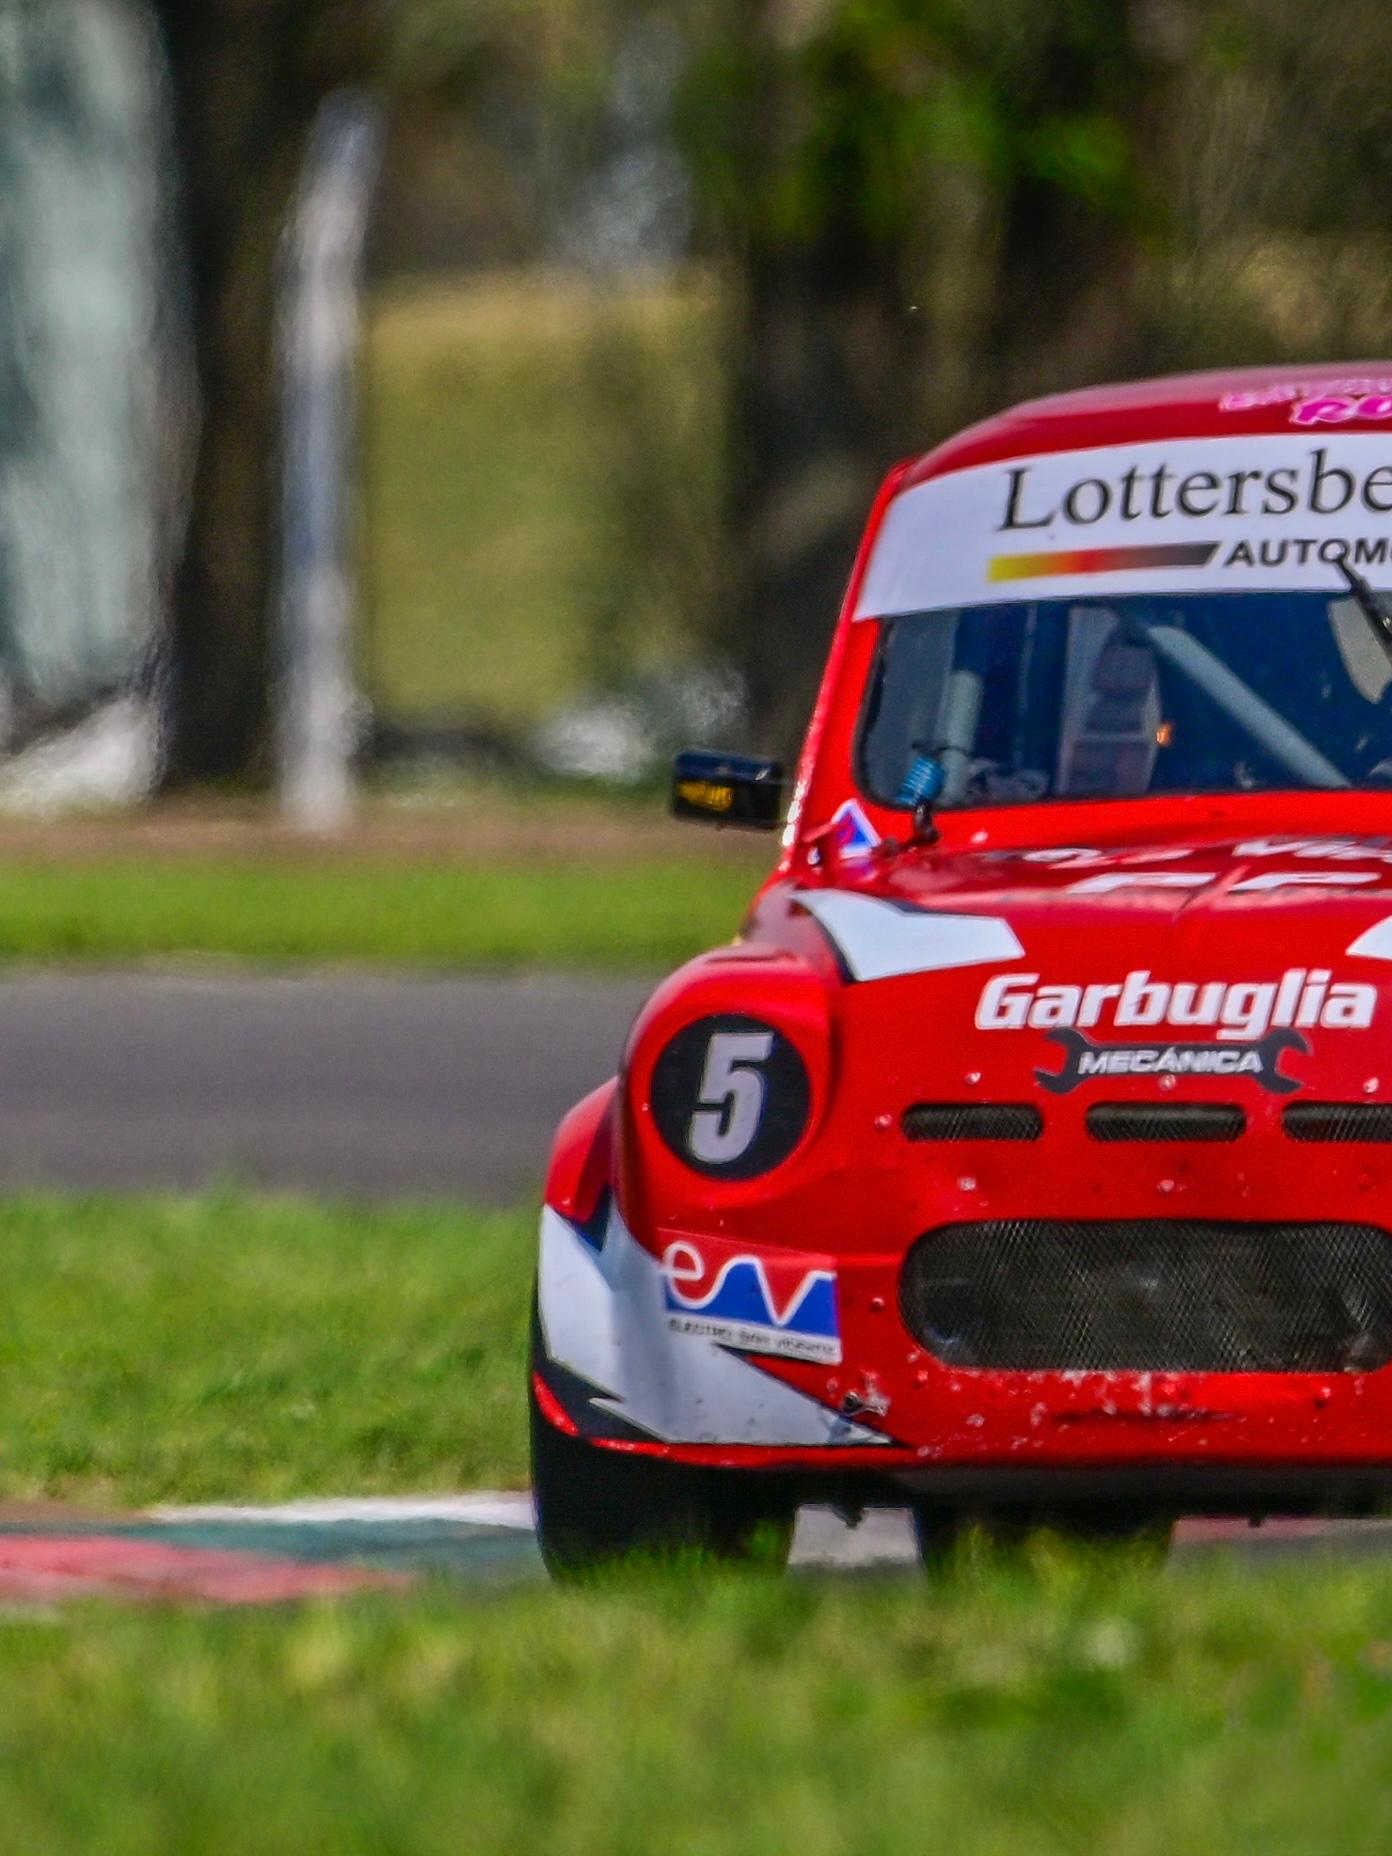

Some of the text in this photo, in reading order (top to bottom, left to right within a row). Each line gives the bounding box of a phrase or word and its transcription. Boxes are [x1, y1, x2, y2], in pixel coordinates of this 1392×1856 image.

[975, 969, 1378, 1041] Garbuglia
[1079, 1046, 1264, 1076] MECÁNICA
[688, 1031, 775, 1165] 5
